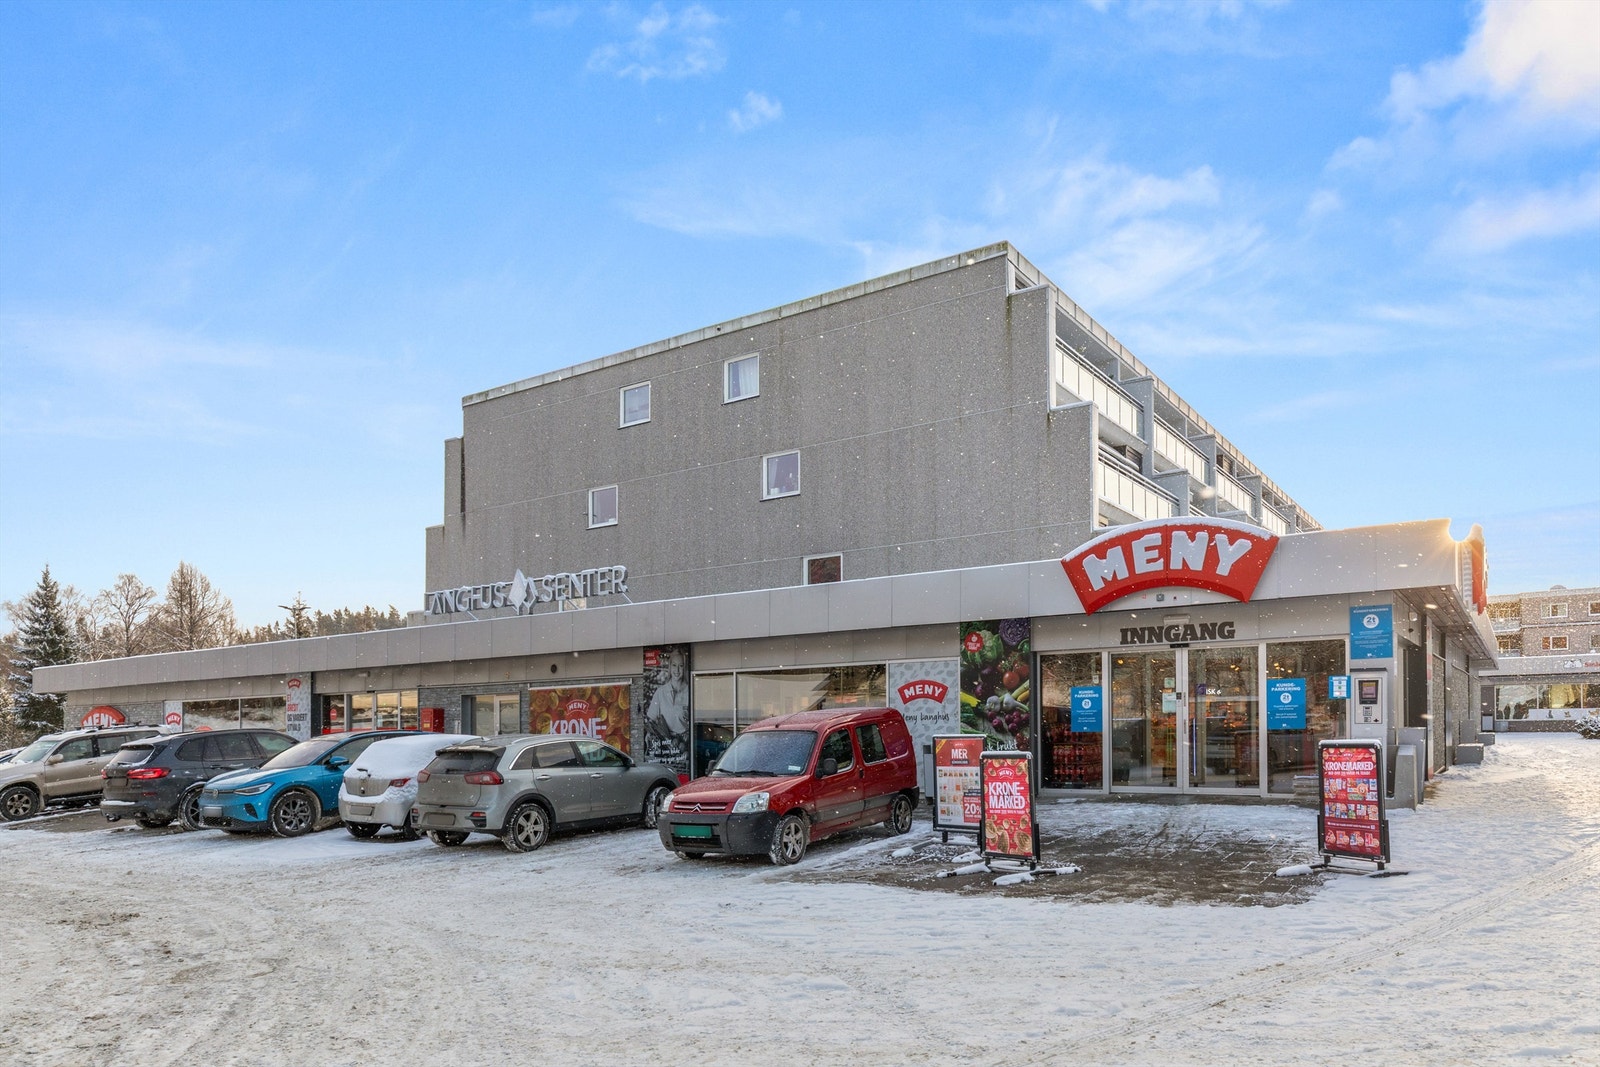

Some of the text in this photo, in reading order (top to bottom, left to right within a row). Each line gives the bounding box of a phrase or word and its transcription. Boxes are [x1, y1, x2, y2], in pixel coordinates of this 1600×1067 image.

[1082, 531, 1252, 591] MENY
[541, 565, 628, 603] SENTER
[1120, 621, 1236, 645] INNGANG
[903, 684, 943, 699] MENY
[903, 713, 917, 724] eny
[951, 748, 968, 760] MER
[1325, 761, 1374, 771] KRONEMARKED
[989, 781, 1025, 796] KRONE-
[964, 803, 982, 814] 20%
[989, 795, 1026, 810] MARKED
